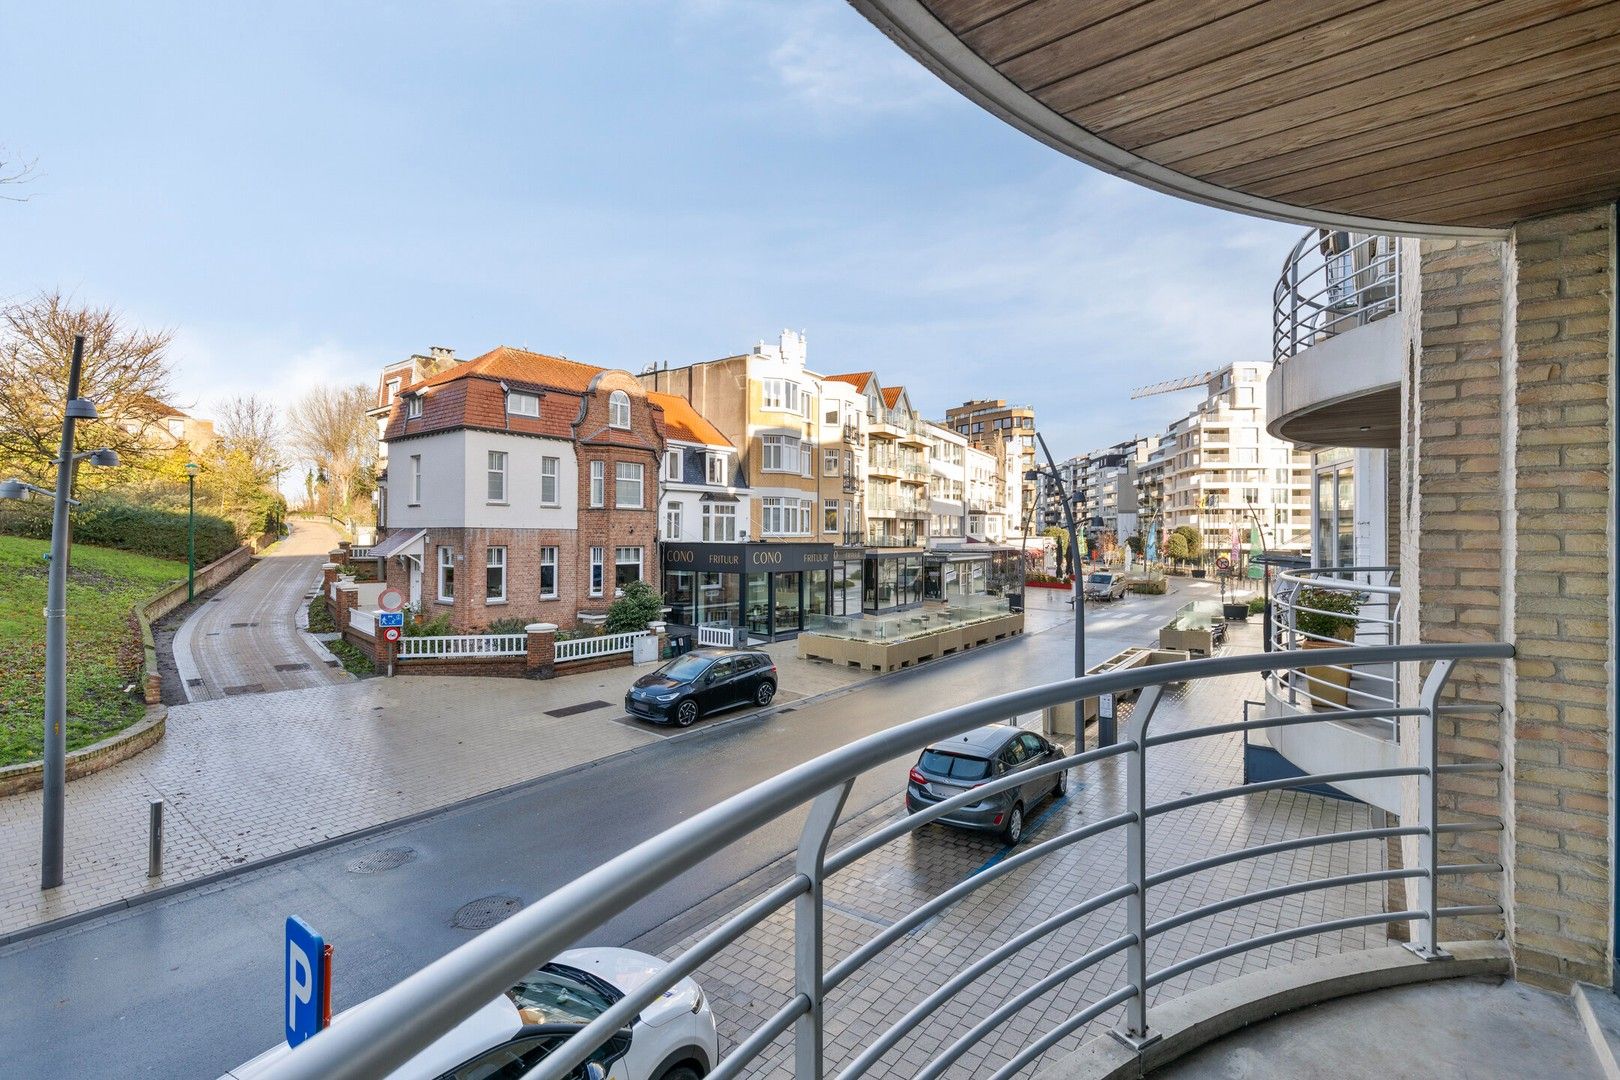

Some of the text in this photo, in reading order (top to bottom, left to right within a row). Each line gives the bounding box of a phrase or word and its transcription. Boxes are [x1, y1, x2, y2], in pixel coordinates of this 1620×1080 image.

[666, 550, 739, 564] CONO FRITUUR
[753, 551, 782, 564] CONO
[803, 553, 829, 563] FRITUUR
[289, 939, 313, 1032] P
